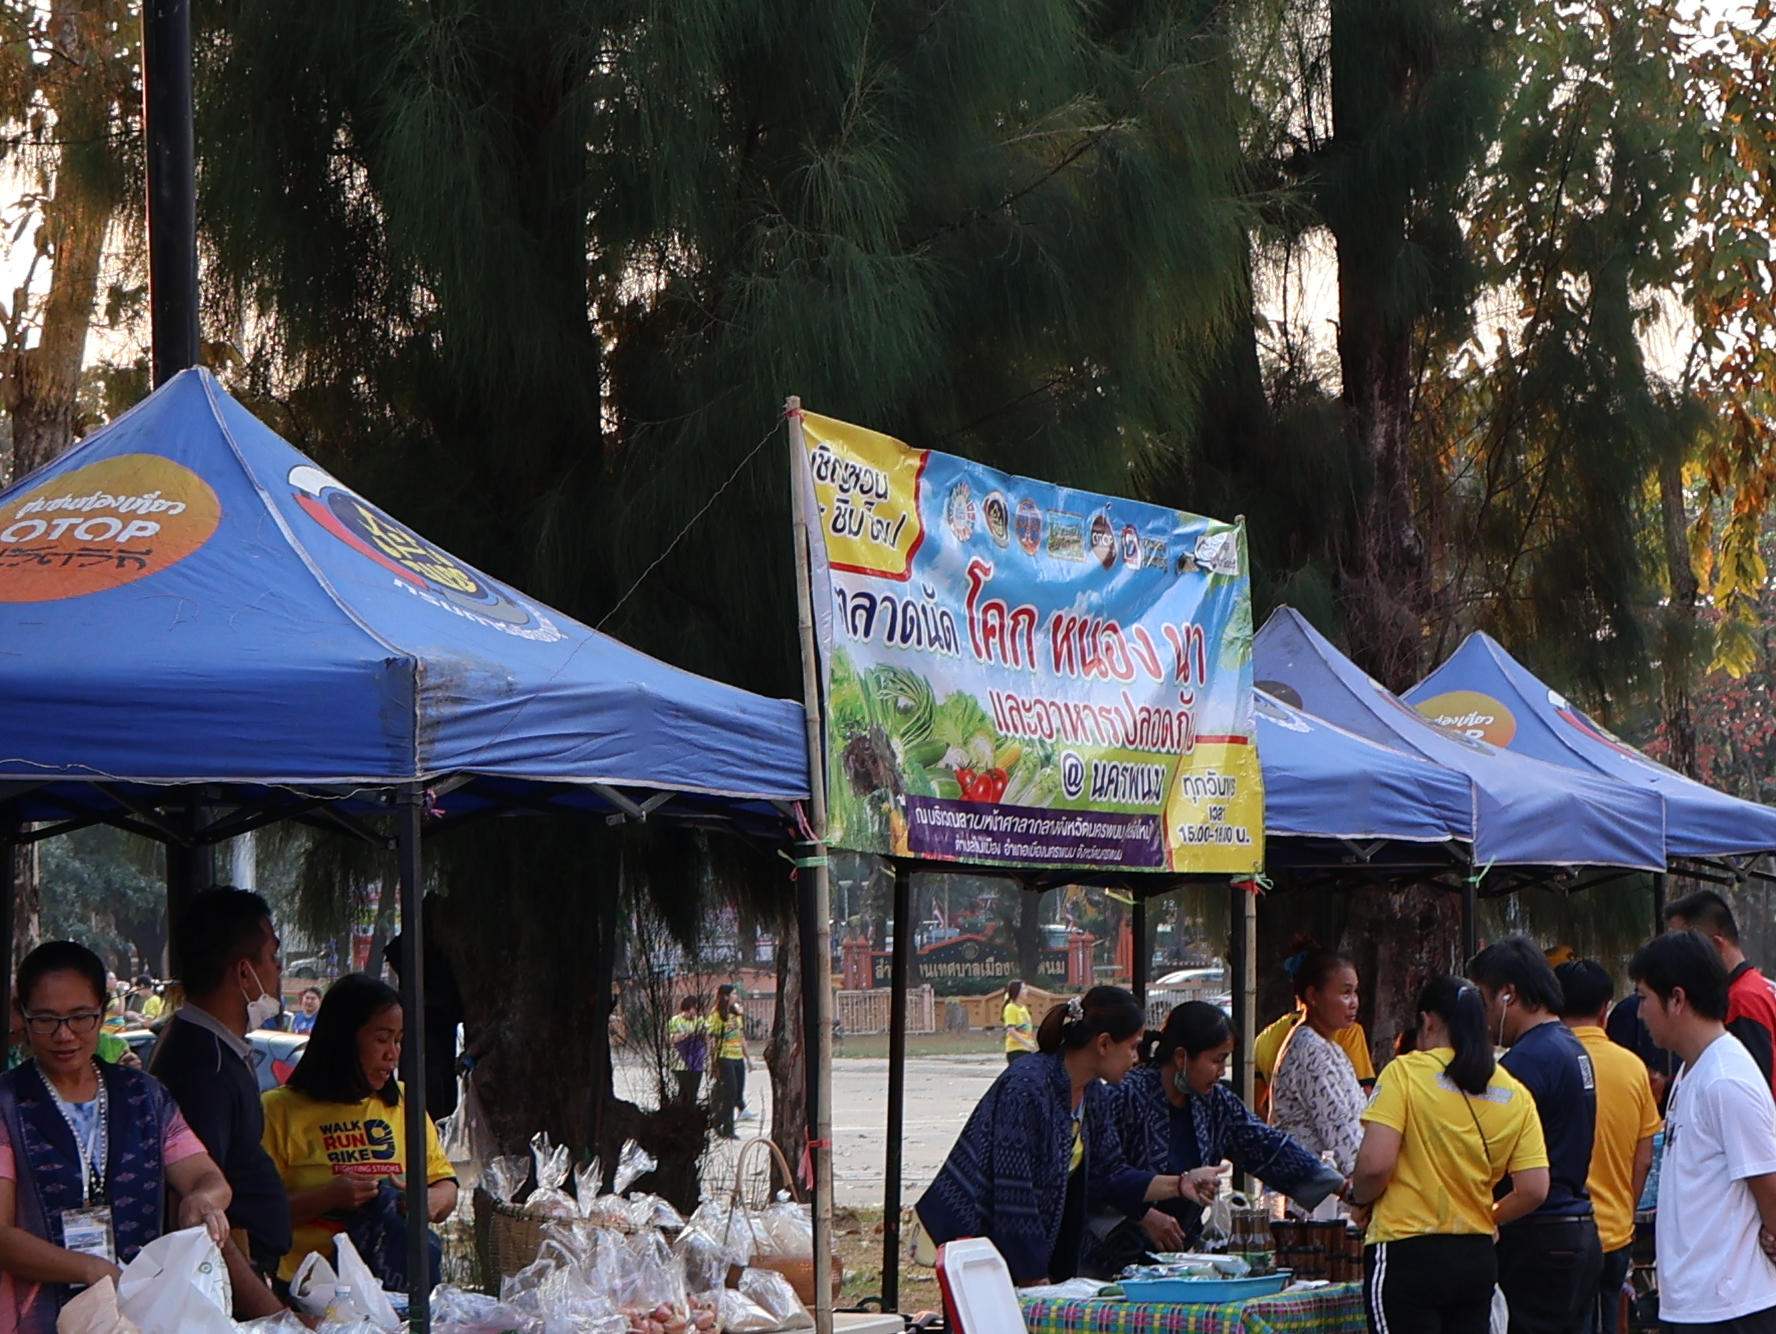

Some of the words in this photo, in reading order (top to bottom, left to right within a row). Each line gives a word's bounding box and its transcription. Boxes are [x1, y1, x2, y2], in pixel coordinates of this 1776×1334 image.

[0, 517, 161, 543] OTOP
[834, 584, 959, 655] ตลาดนัด
[967, 560, 1036, 669] โคก
[1052, 614, 1162, 680] หนอง
[1164, 623, 1205, 684] นา
[1091, 762, 1166, 802] นครพนม
[319, 1120, 362, 1134] WALK
[323, 1133, 366, 1150] RUN
[327, 1149, 371, 1162] BIKE
[372, 1165, 401, 1173] STROKE
